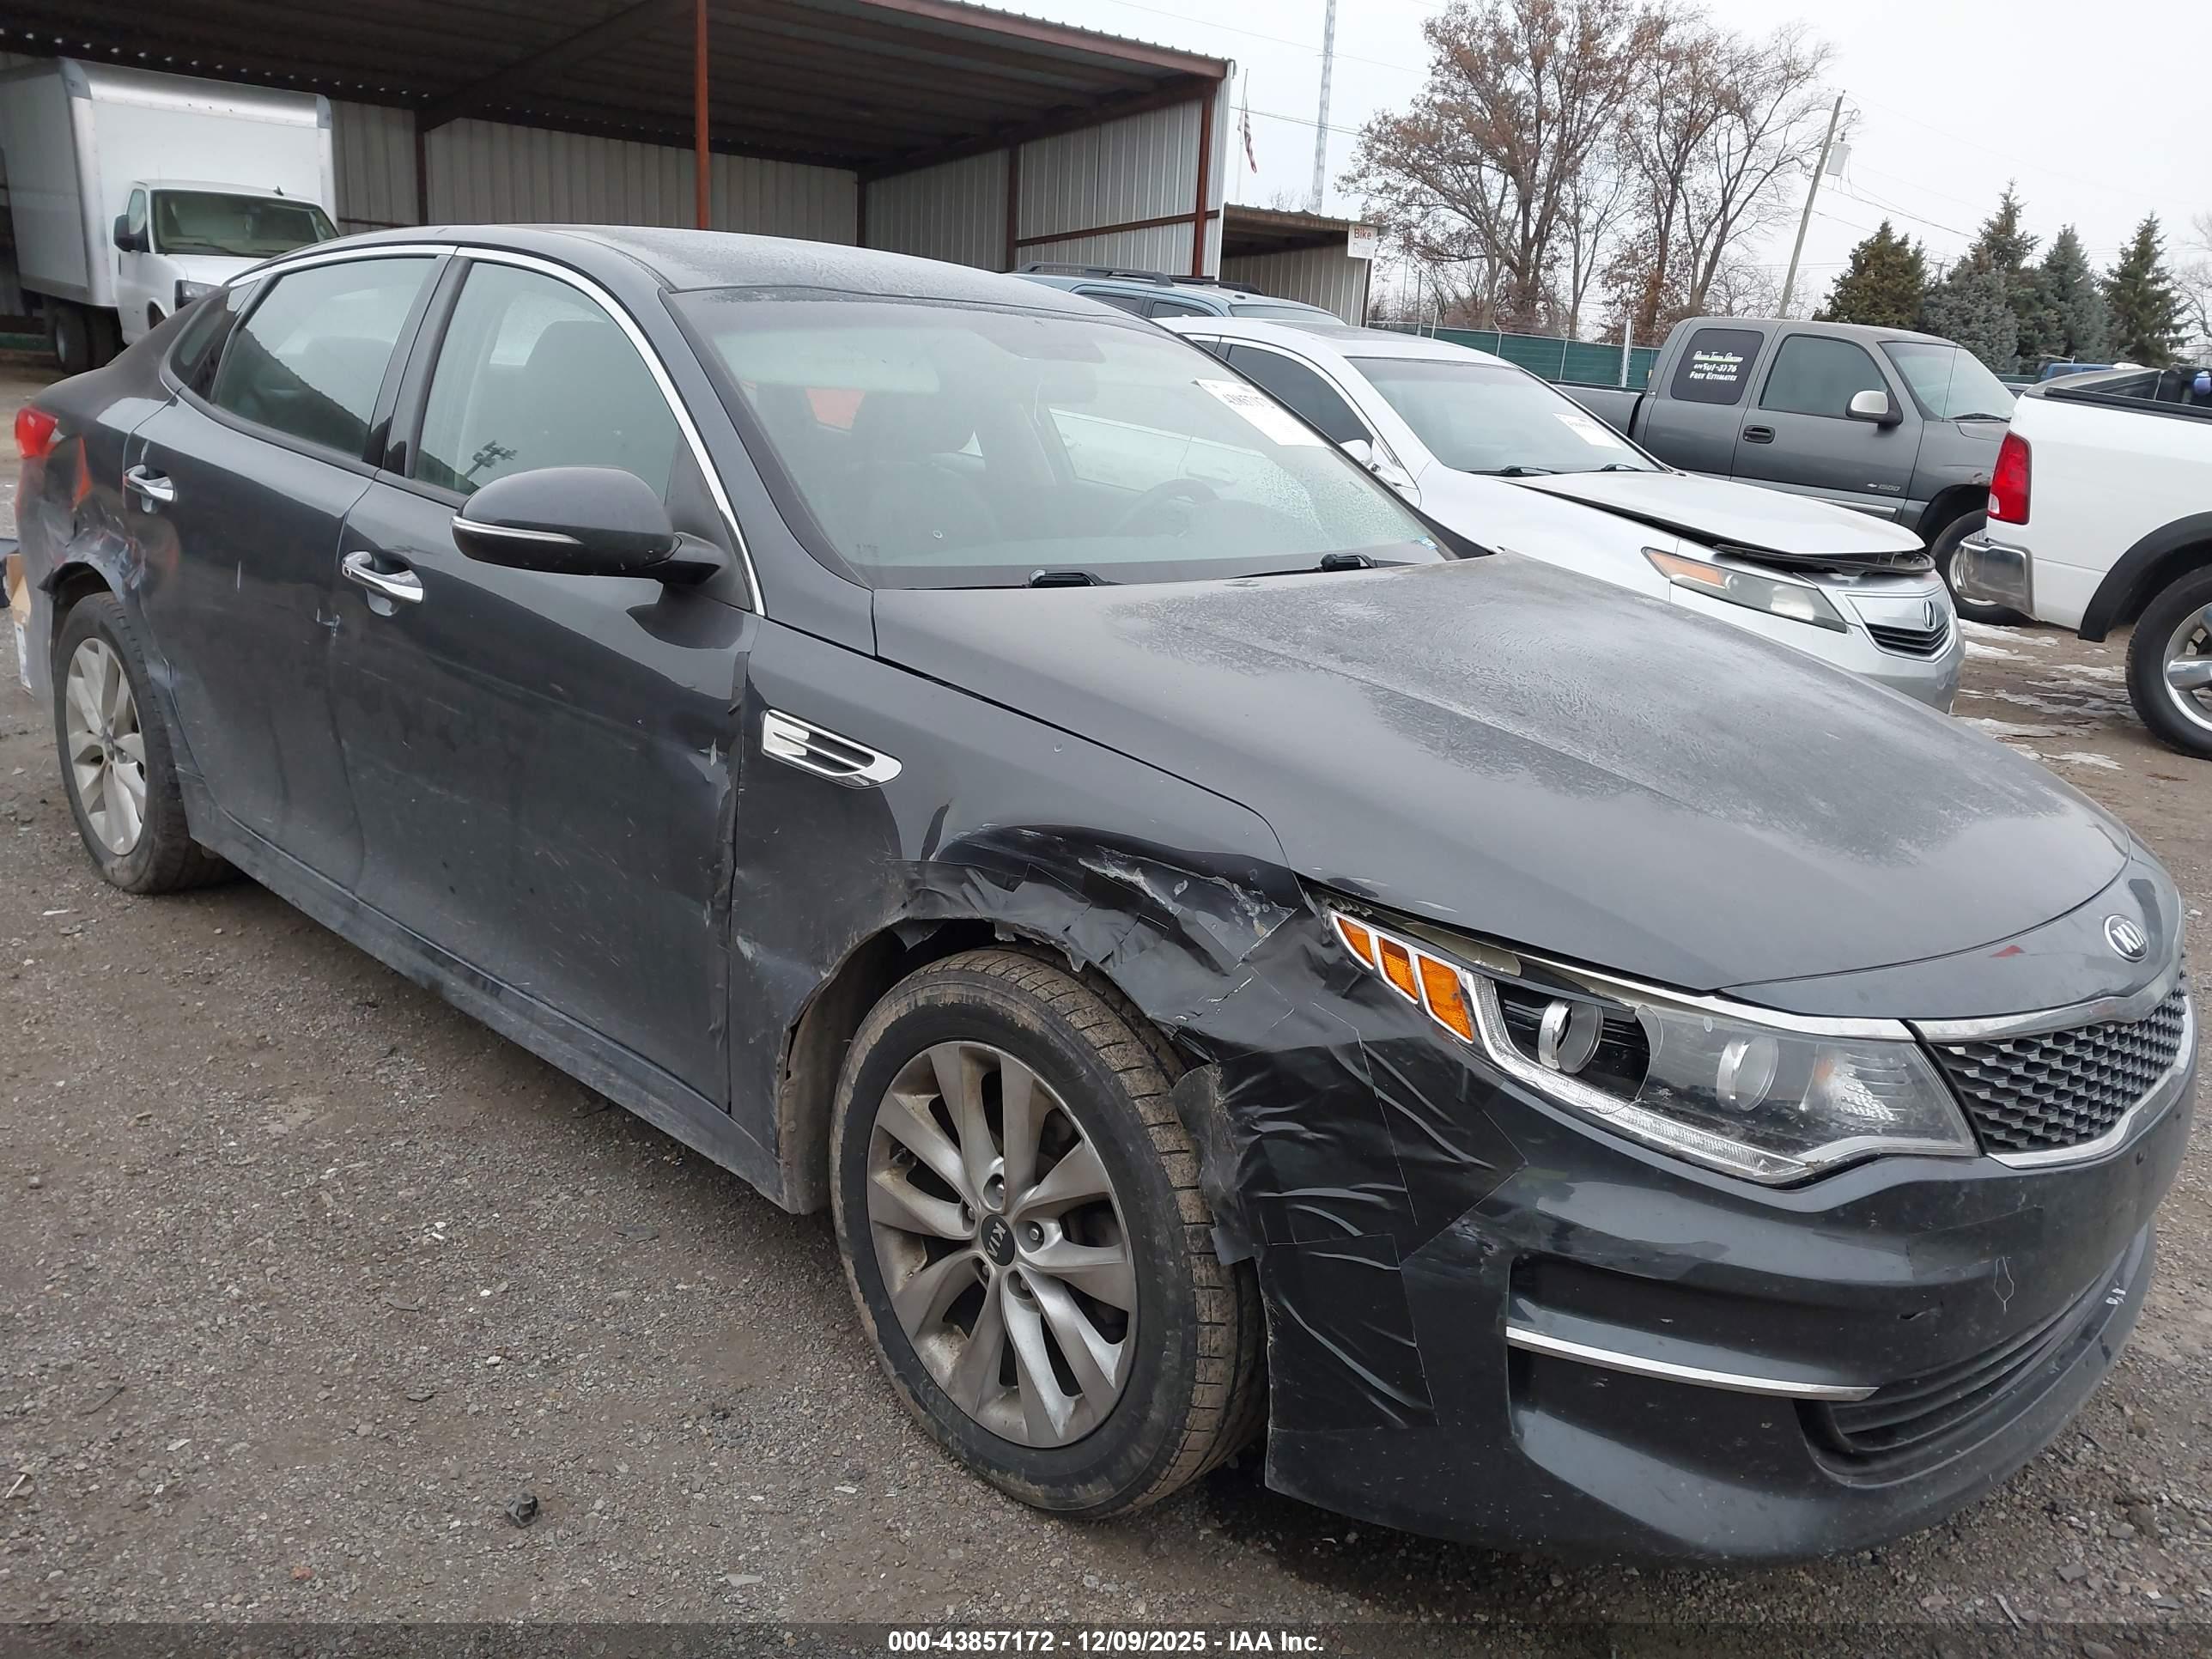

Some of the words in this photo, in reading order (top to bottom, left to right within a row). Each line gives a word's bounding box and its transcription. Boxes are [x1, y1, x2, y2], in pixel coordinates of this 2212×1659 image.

[1353, 227, 1372, 240] Bike
[2111, 920, 2145, 954] KIA
[987, 1221, 1006, 1258] KIA
